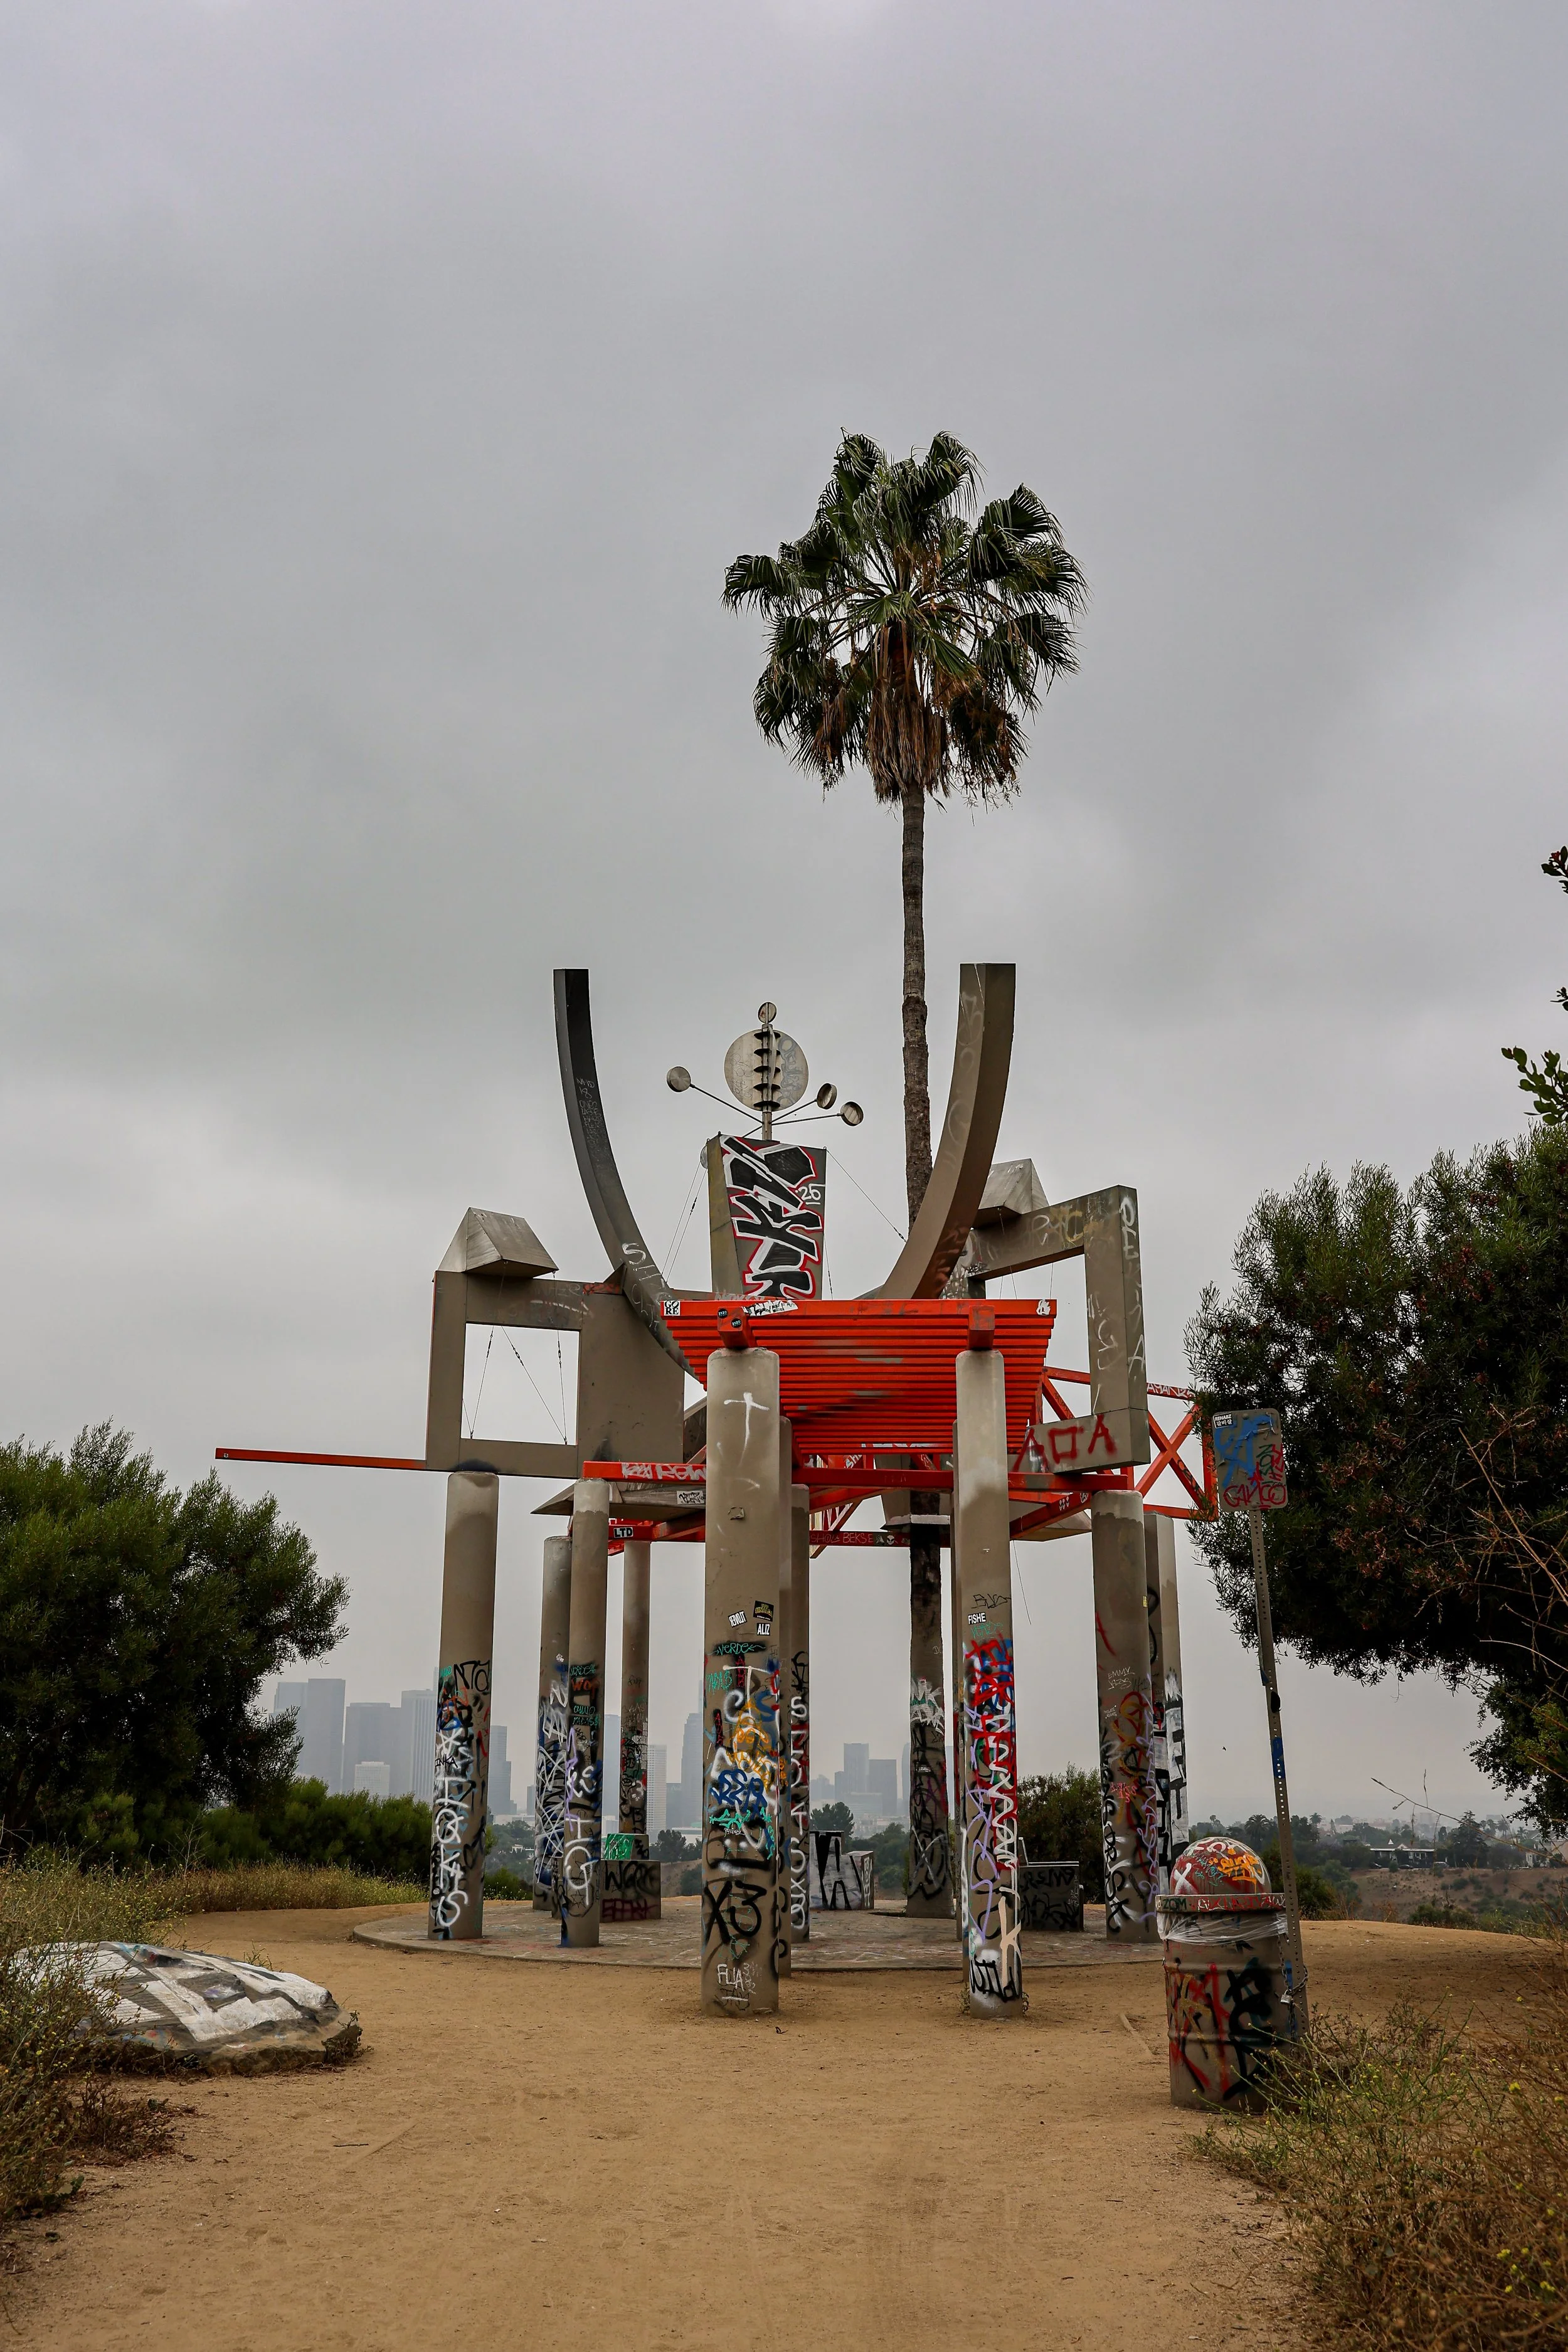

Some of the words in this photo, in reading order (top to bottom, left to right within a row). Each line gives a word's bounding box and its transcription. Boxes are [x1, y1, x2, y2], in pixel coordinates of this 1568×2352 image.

[614, 1527, 633, 1537] LTD
[968, 1613, 987, 1624] FISHE
[757, 1623, 770, 1635] ALIZ
[1108, 1666, 1135, 1680] EMMY
